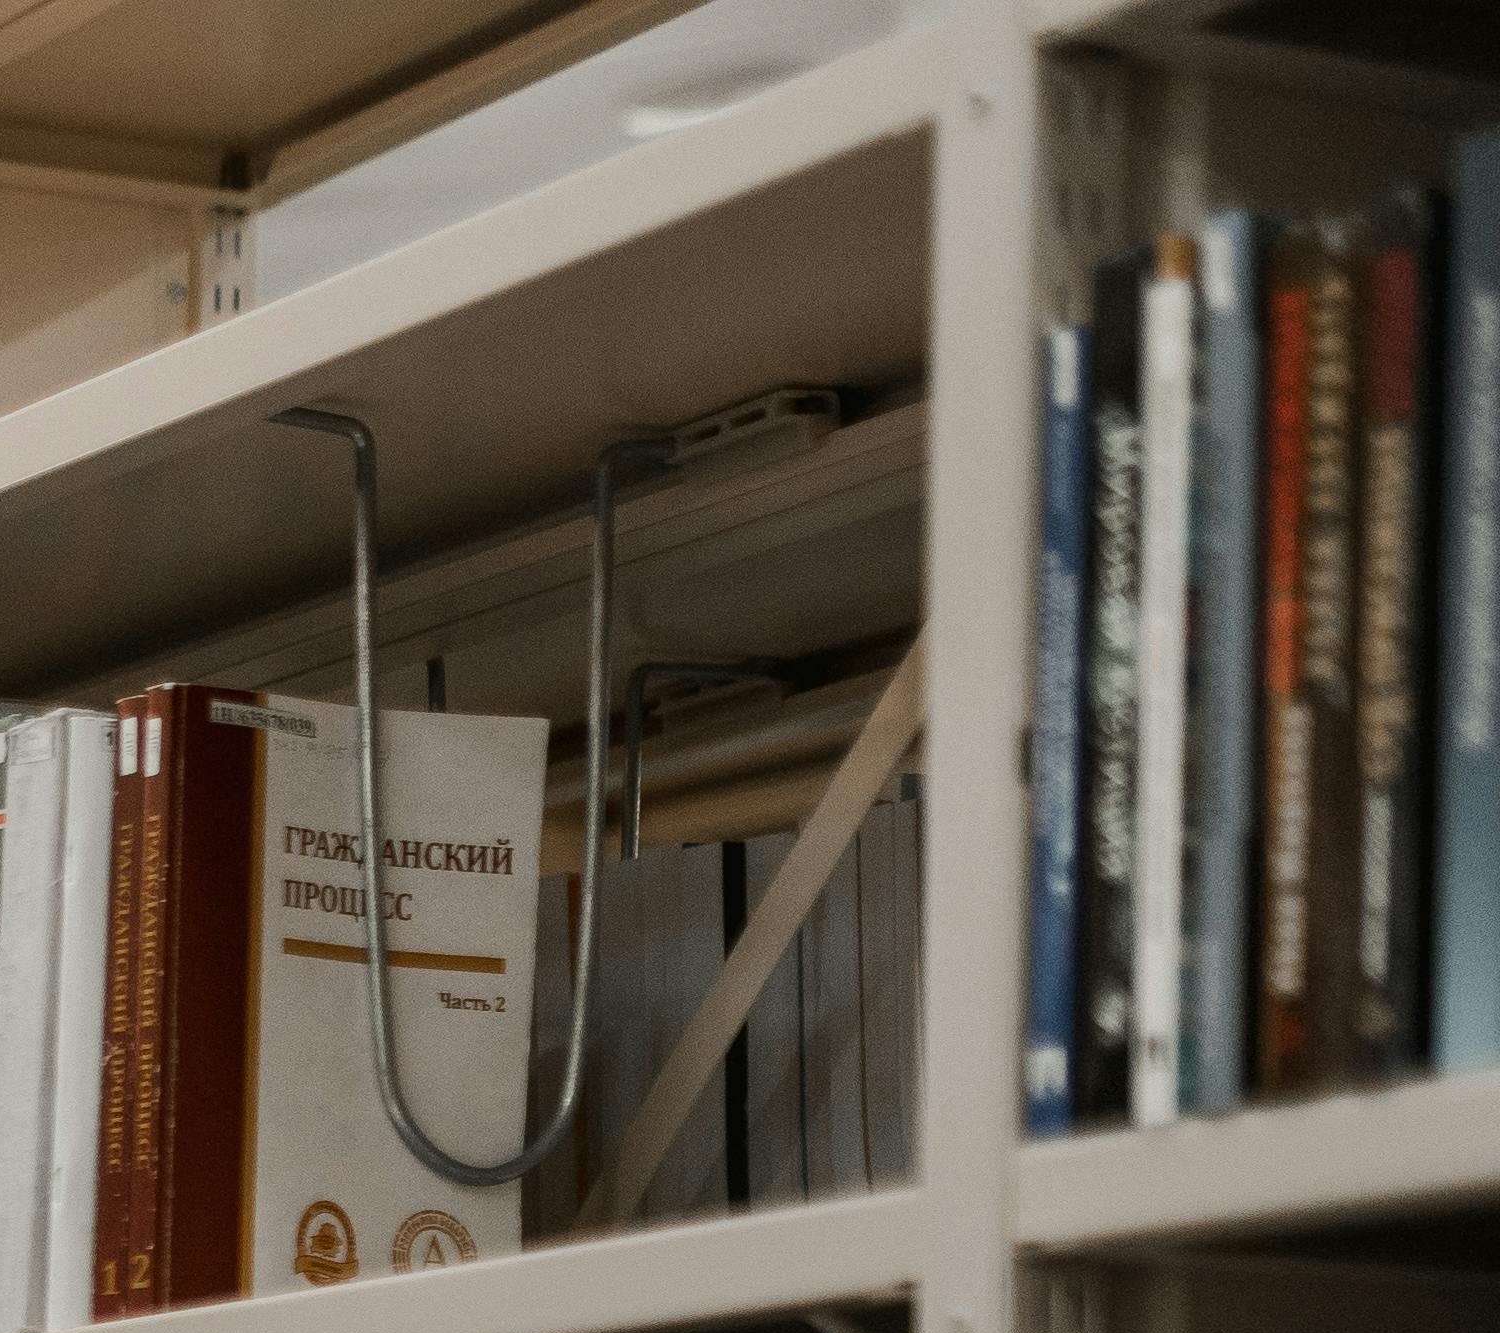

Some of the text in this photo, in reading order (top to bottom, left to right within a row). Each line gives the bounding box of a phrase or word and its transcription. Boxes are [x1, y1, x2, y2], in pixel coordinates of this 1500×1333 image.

[285, 826, 514, 876] ГРАЖАНСКИЙ
[284, 879, 412, 922] ПРОЦСС
[106, 822, 134, 1173] ГРАЖДАНСКИЙ ПРОЦЕСС
[136, 814, 161, 1169] ГРАЖДАНСКИЙ ПРОЦЕСС
[439, 990, 507, 1014] Часть 2
[102, 1260, 117, 1296] 1
[129, 1252, 150, 1291] 2
